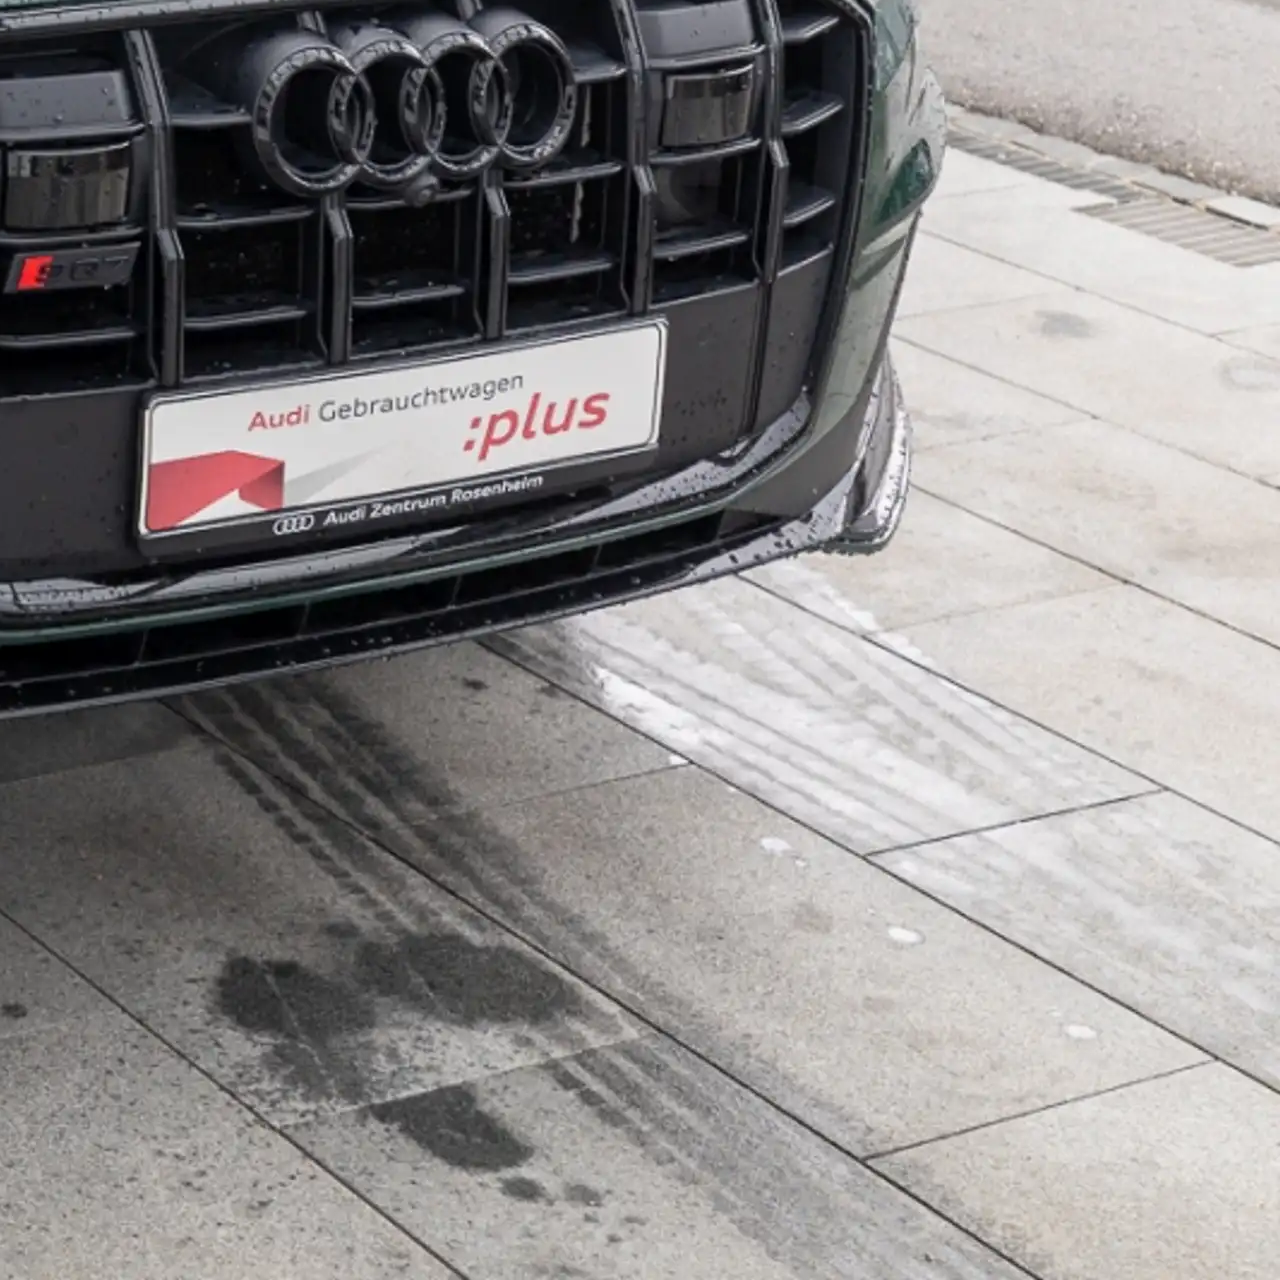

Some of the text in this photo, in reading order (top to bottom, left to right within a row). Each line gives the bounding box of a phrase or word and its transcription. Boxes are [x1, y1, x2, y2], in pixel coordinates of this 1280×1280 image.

[248, 375, 524, 431] Audi Gebrauchtwagen
[322, 475, 544, 527] Audi Zentrum Rosenheim
